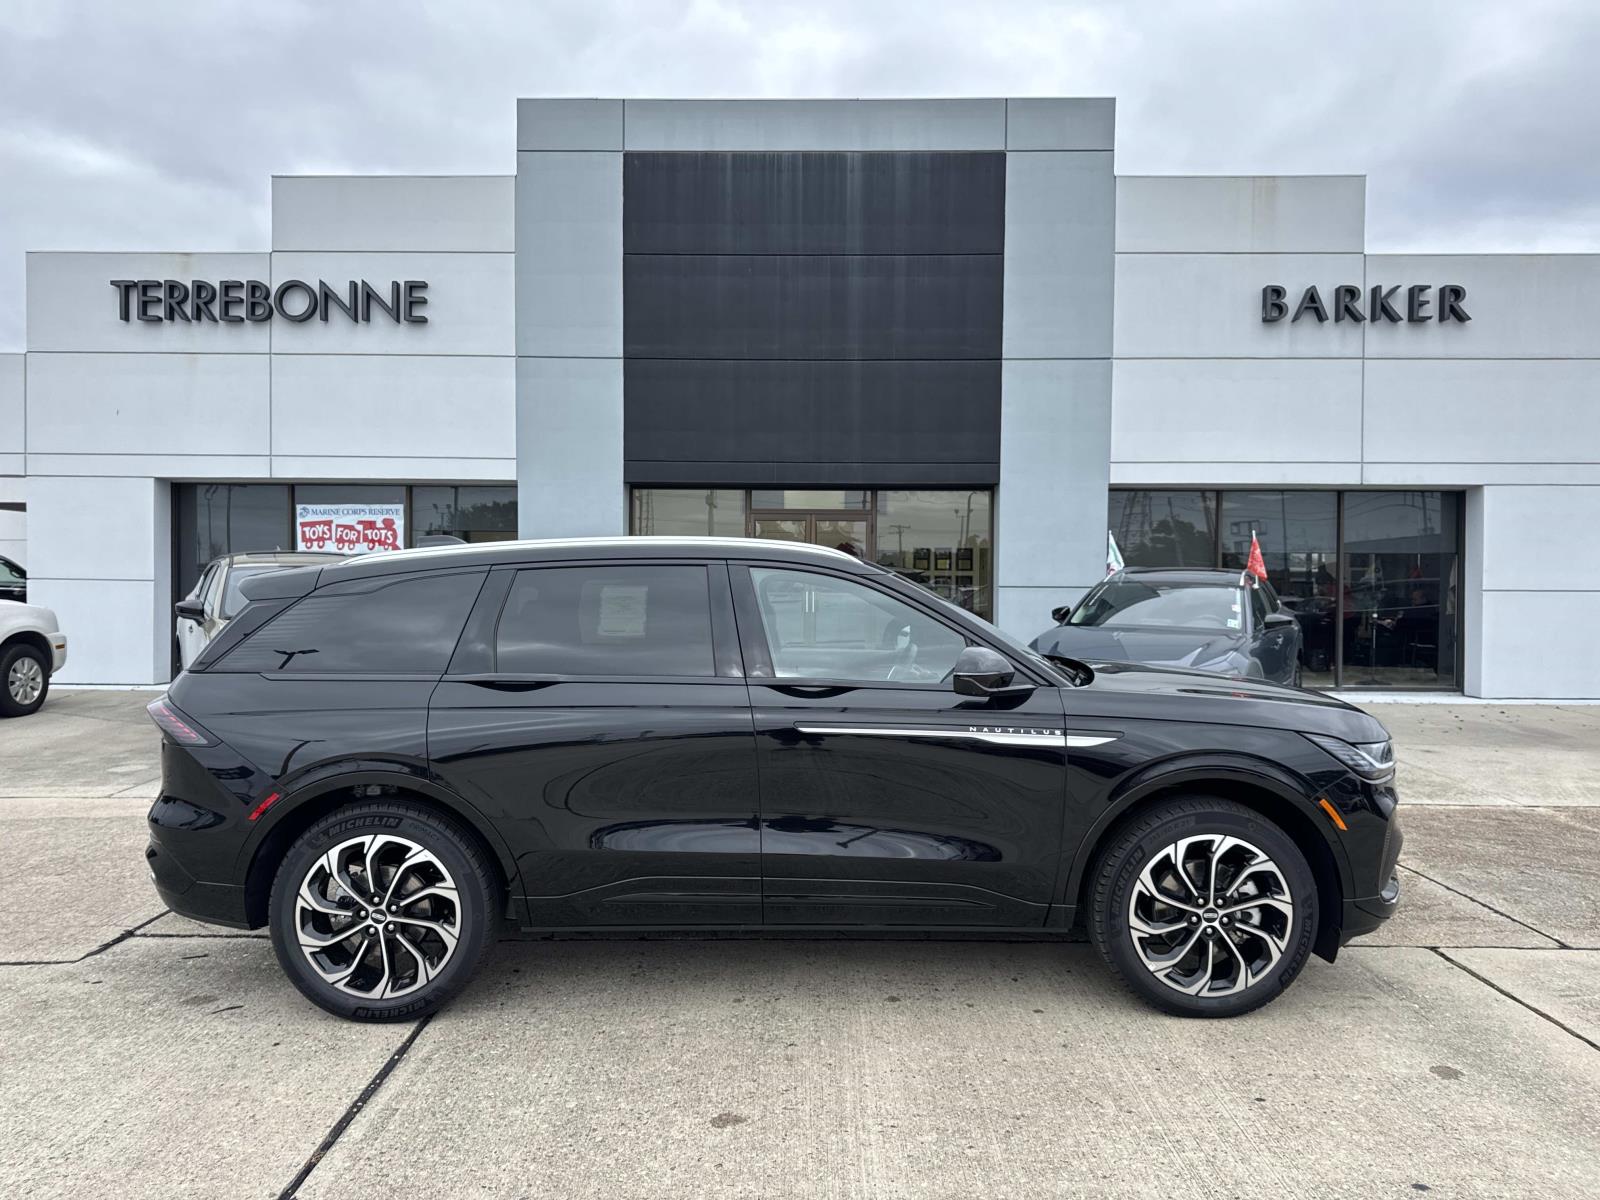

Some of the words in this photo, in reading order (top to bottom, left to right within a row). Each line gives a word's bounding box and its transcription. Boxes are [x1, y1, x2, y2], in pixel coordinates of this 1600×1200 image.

[110, 279, 428, 323] TERREBONNE
[1262, 285, 1472, 323] BARKER
[311, 508, 340, 516] MARINE
[342, 508, 367, 516] CORPS
[368, 508, 400, 516] RESERVE
[303, 524, 330, 539] TOYS
[336, 528, 358, 541] FOR
[364, 529, 393, 543] TOTS
[969, 726, 1061, 735] NAUTILUS
[329, 817, 399, 836] MICHELIN
[356, 999, 426, 1018] MICHELIN
